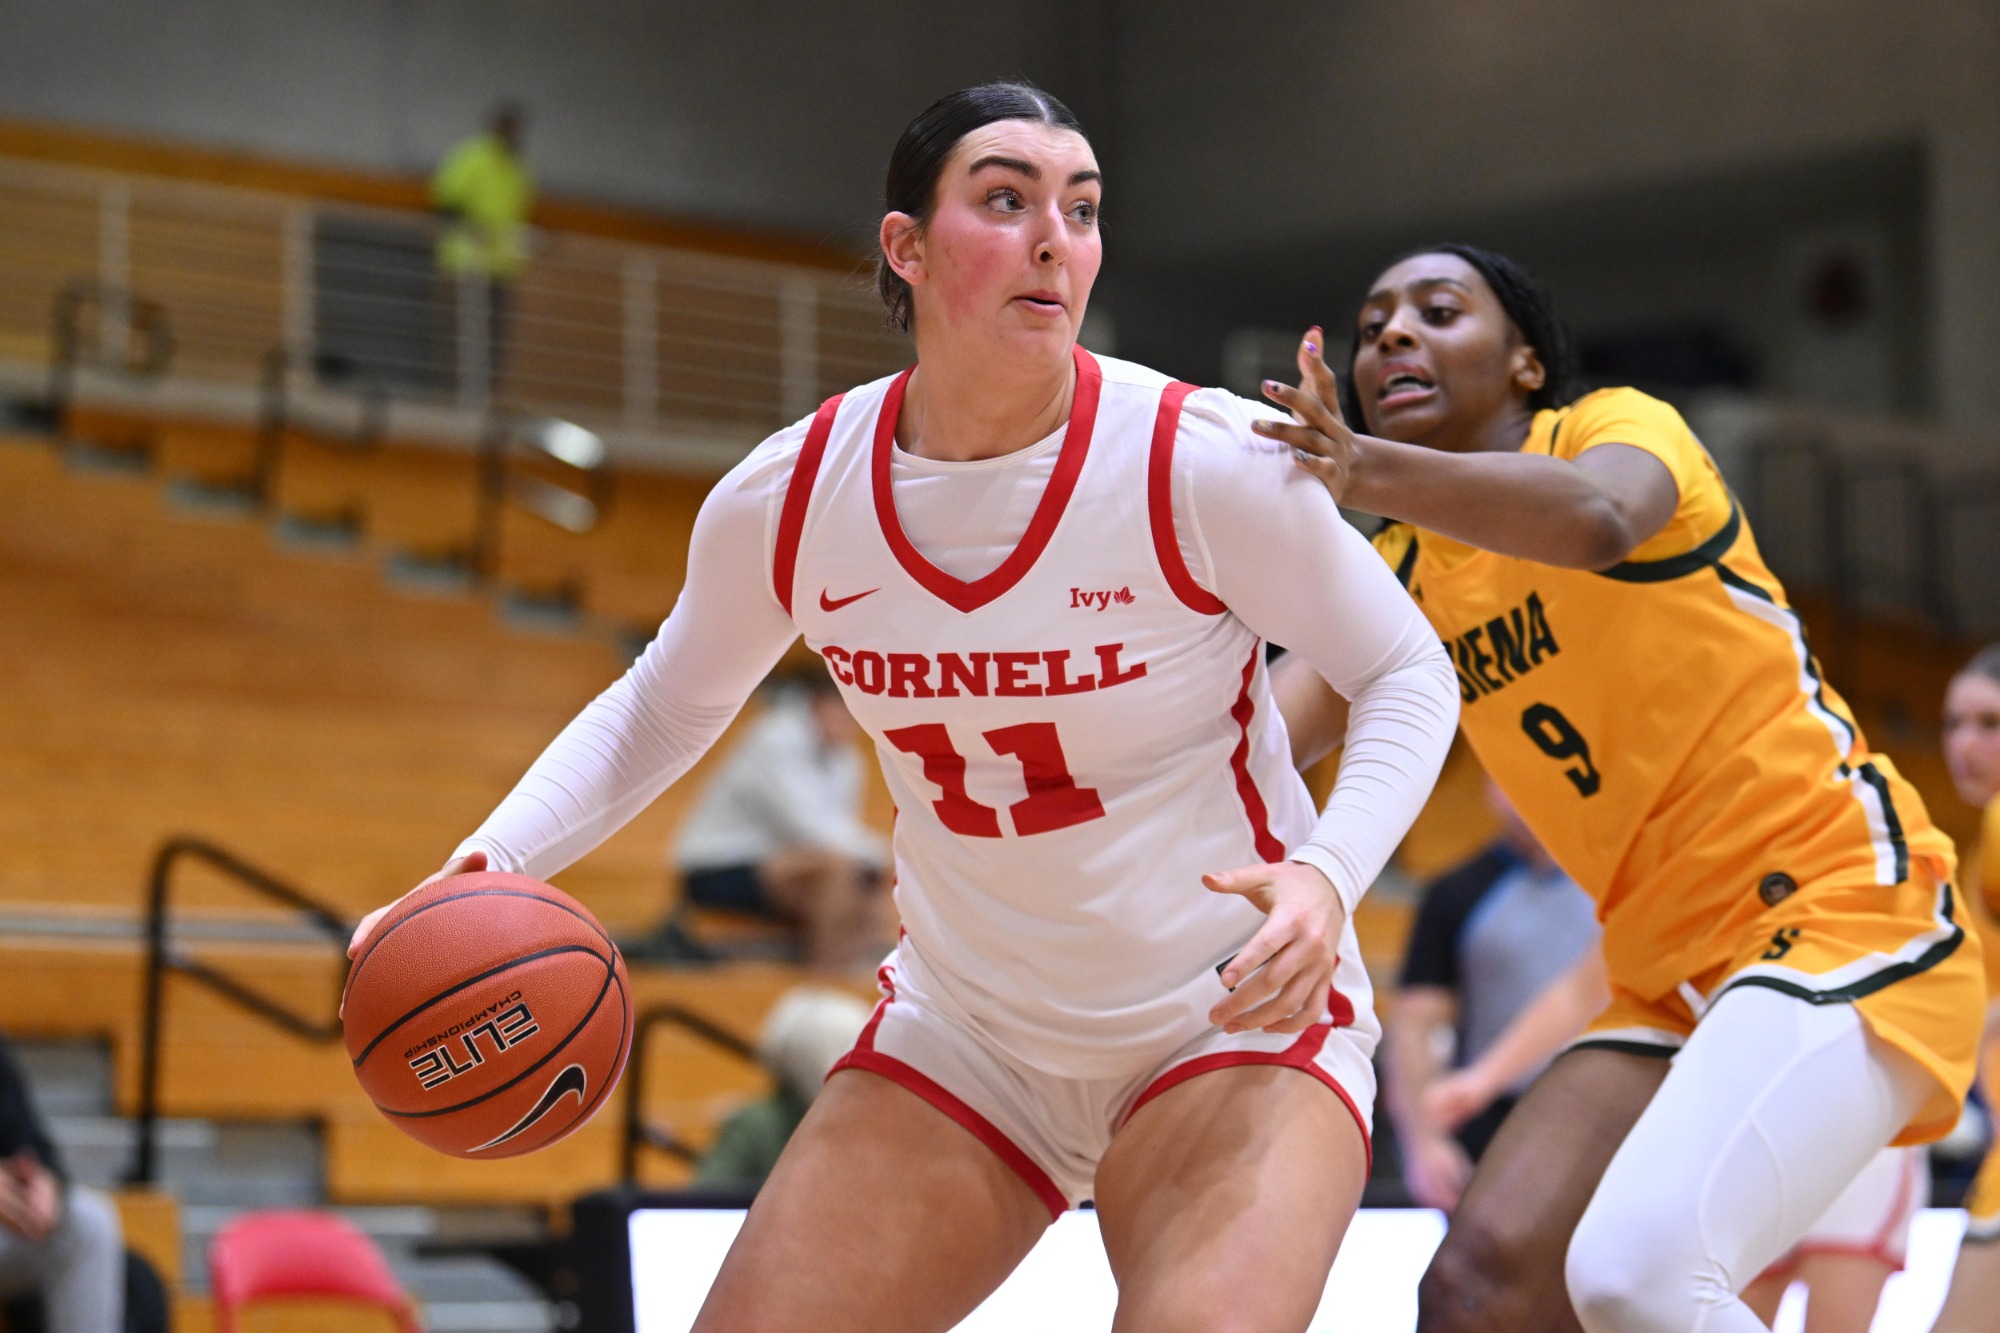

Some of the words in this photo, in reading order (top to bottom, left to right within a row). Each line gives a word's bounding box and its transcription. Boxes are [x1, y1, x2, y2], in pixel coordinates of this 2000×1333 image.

[1069, 587, 1112, 612] Ivy
[821, 642, 1147, 698] CORNELL
[882, 722, 1106, 838] 11
[1521, 702, 1601, 798] 9
[1761, 928, 1801, 960] S
[404, 990, 522, 1059] CHAMPIONSHIP
[408, 1001, 540, 1091] ELITE
